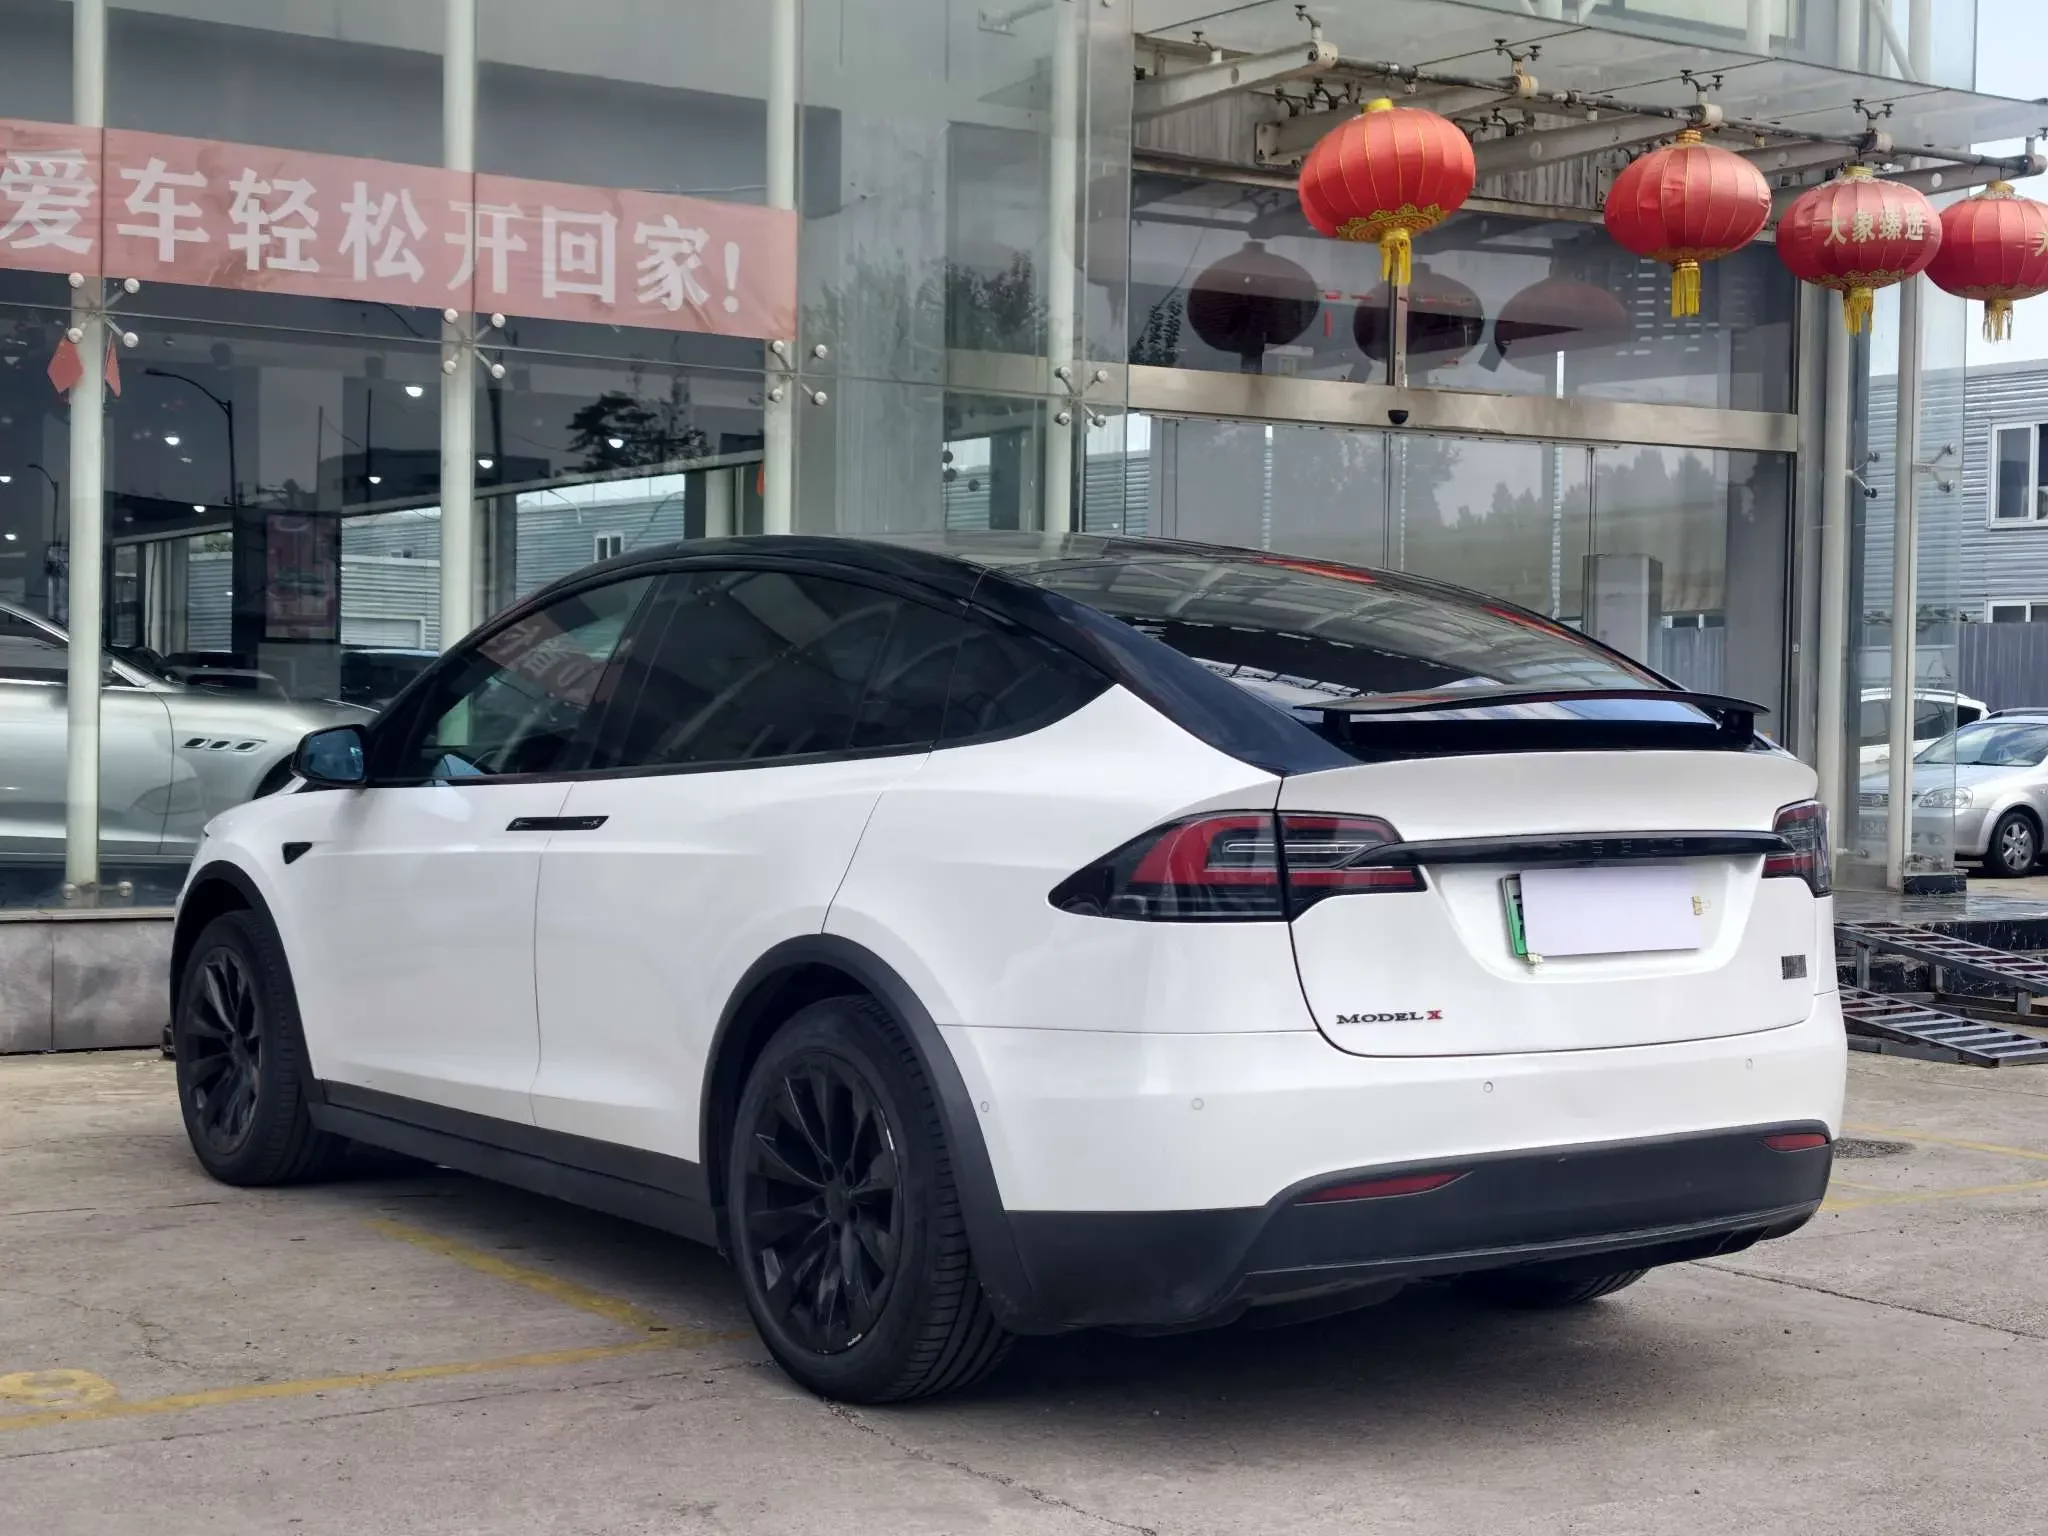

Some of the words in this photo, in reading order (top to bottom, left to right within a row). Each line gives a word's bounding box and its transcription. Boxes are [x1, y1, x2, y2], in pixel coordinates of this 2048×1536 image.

[0, 148, 740, 313] 爱车轻松开回家!
[1336, 1011, 1424, 1024] MODEL
[1426, 1009, 1443, 1021] X
